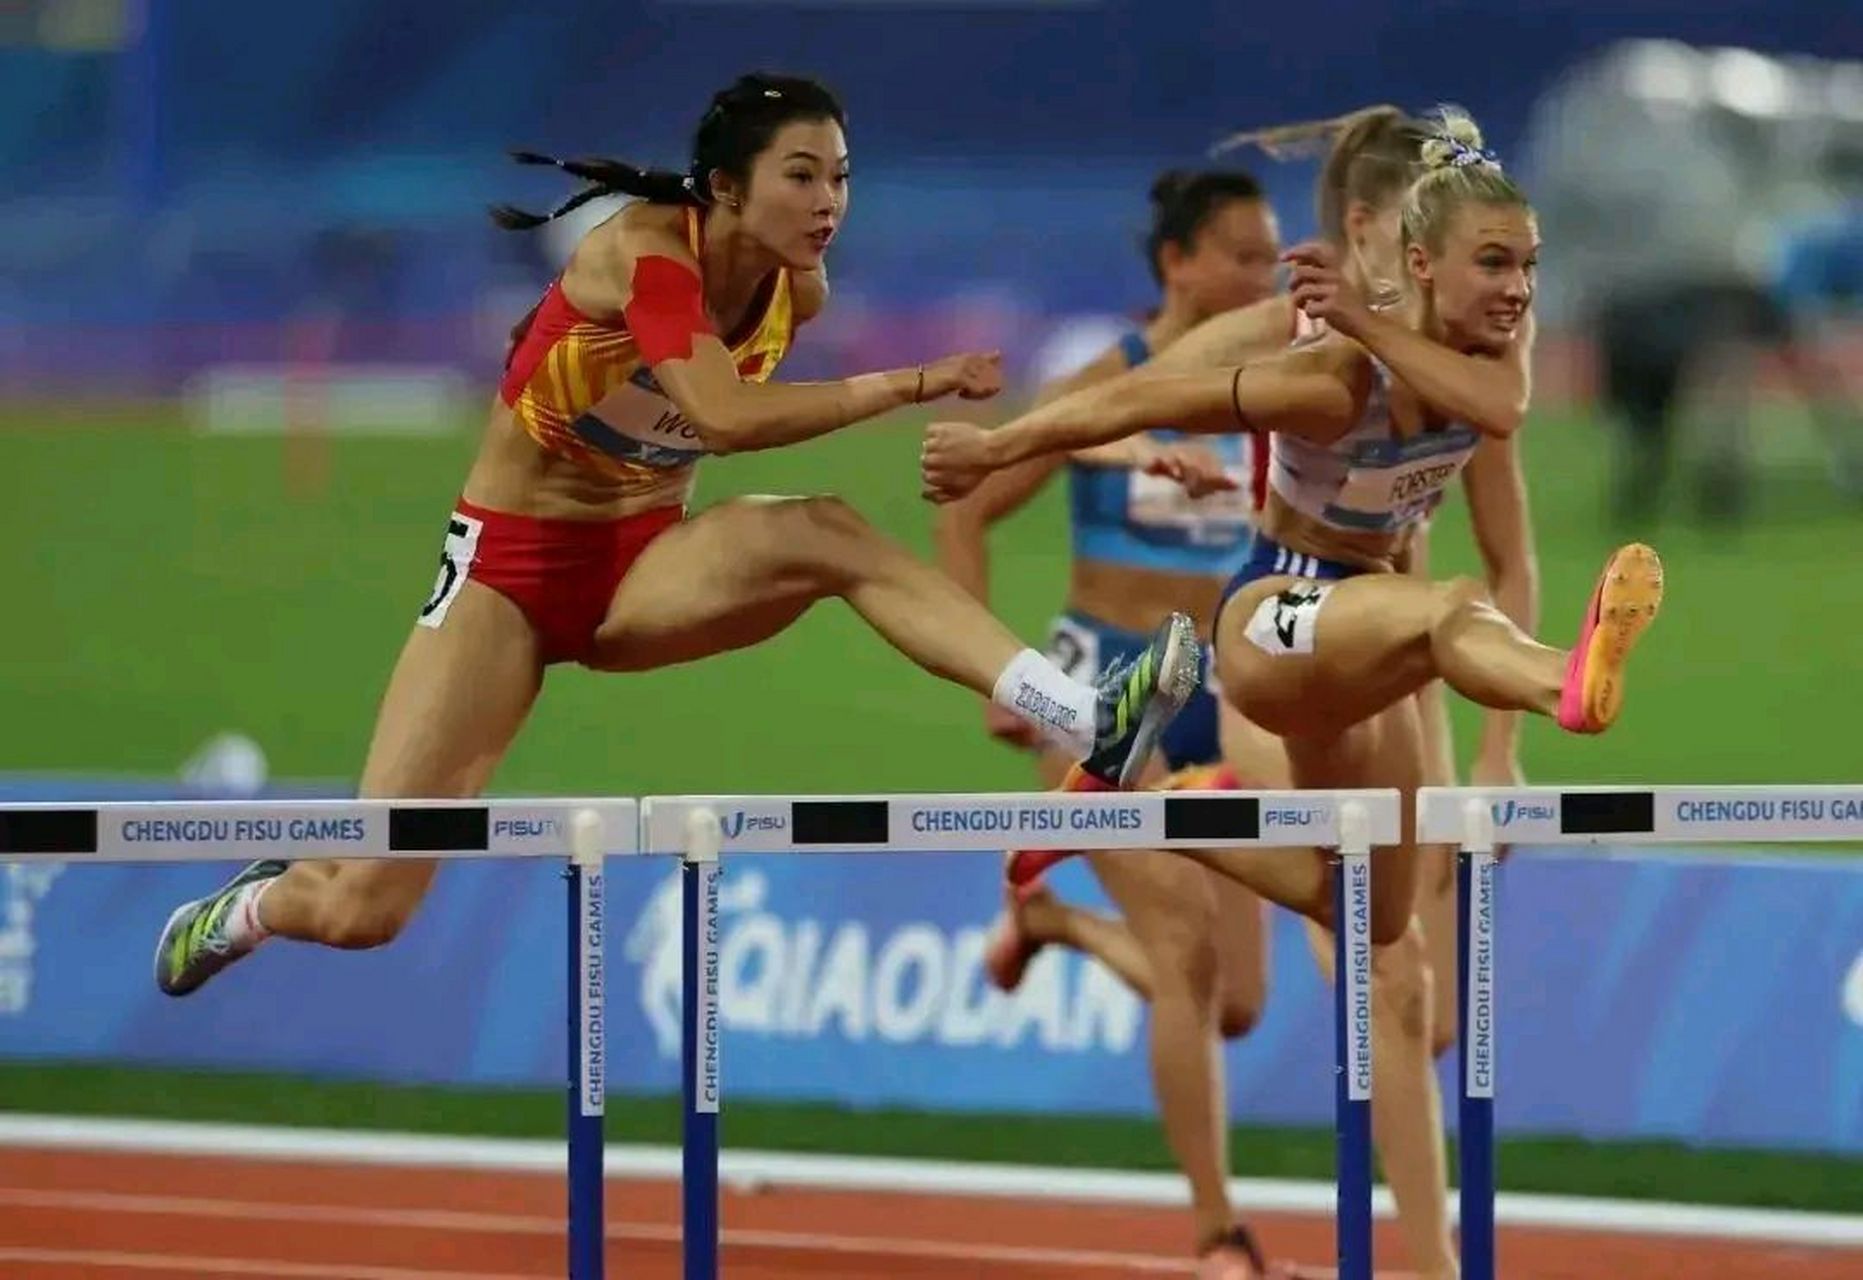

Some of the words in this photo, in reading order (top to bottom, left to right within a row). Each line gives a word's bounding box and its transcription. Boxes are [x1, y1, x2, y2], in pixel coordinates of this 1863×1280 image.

[122, 820, 228, 842] CHENGDU
[235, 819, 282, 841] FISU
[289, 818, 365, 841] GAMES
[912, 810, 1012, 831] CHENGDU
[1019, 809, 1063, 830] FISU
[1071, 808, 1142, 830] GAMES
[1517, 806, 1554, 819] FISU
[1677, 801, 1775, 821] CHENGDU
[1782, 800, 1824, 820] FISU
[1831, 800, 1863, 820] GA
[588, 875, 601, 947] GAMES
[707, 872, 718, 943] GAMES
[1352, 863, 1367, 935] GAMES
[1479, 864, 1491, 933] GAMES
[588, 955, 601, 999] FISU
[706, 952, 718, 995] FISU
[1354, 941, 1368, 985] FISU
[1477, 940, 1490, 983] FISU
[588, 1005, 601, 1106] CHENGDU
[705, 1002, 718, 1103] CHENGDU
[1356, 992, 1369, 1090] CHENGDU
[1476, 990, 1490, 1088] CHENGDU
